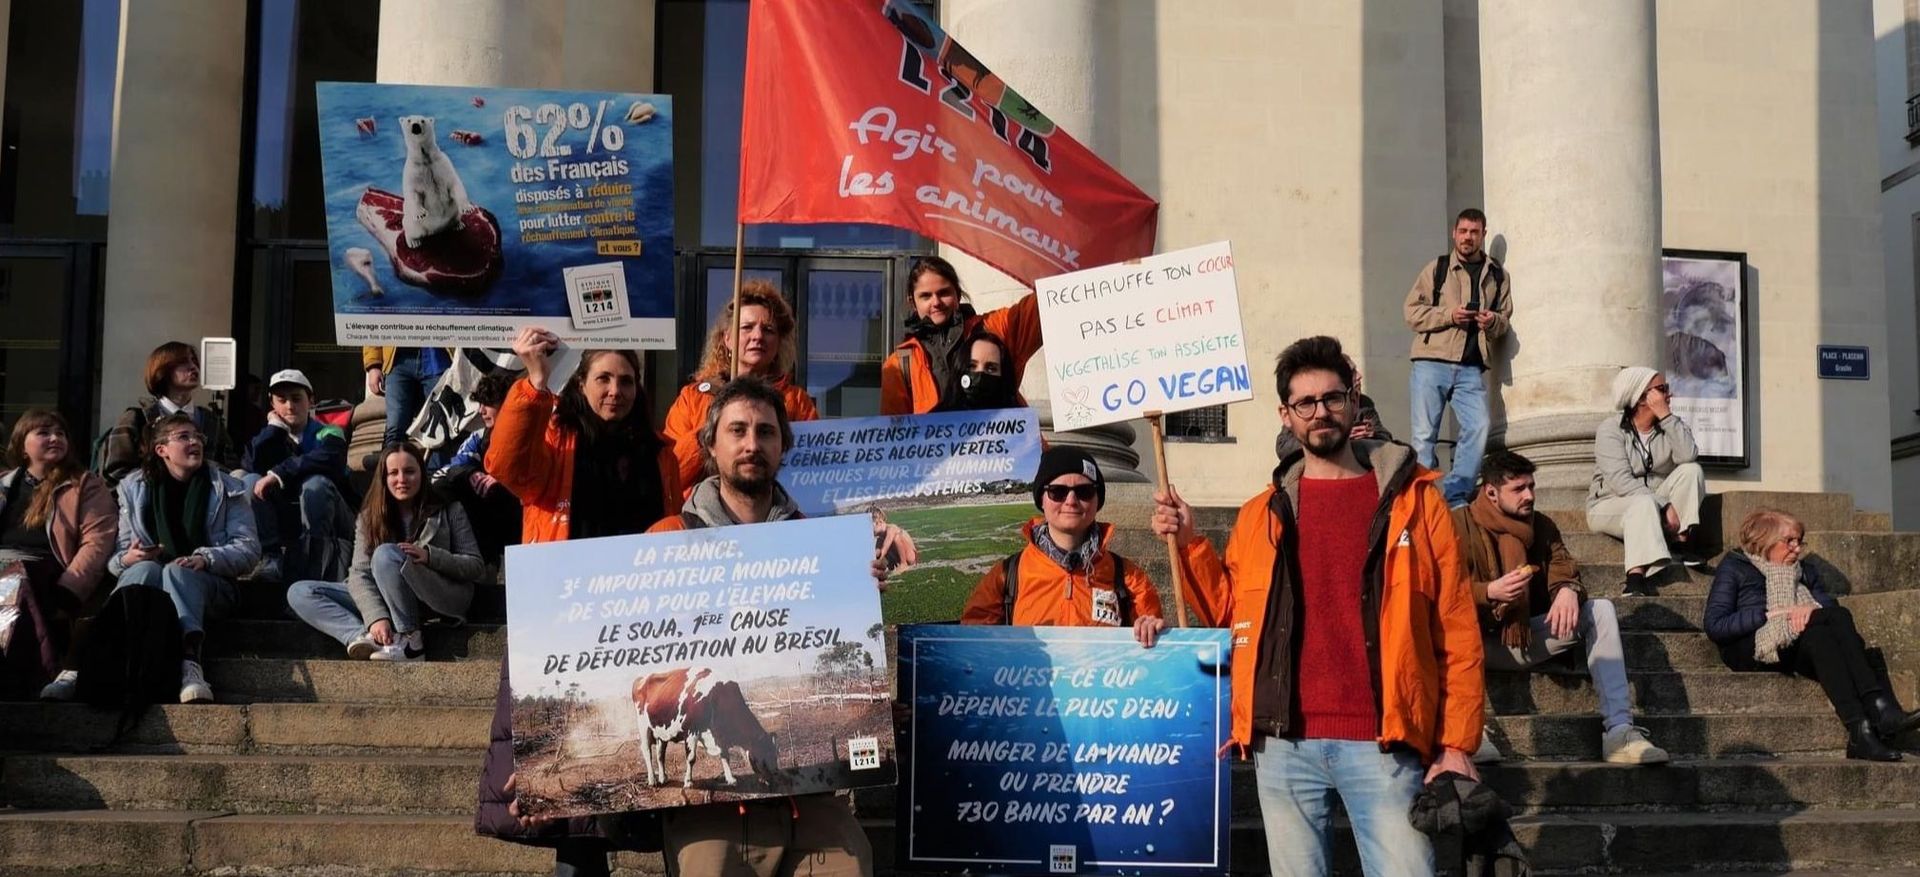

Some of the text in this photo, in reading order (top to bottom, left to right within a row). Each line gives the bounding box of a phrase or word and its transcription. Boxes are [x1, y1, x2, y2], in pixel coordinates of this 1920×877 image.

[898, 34, 1052, 175] L214
[504, 100, 624, 159] 62%
[510, 155, 629, 183] des Français
[849, 107, 1064, 217] Agir pour
[515, 182, 632, 204] disposés à réduire
[520, 209, 636, 232] pour lutter contre le
[839, 155, 1081, 269] les animaux
[600, 243, 610, 252] et
[613, 244, 632, 252] vous
[1046, 270, 1154, 308] RECHAUFFE
[1163, 264, 1192, 281] TON
[346, 323, 379, 331] L'élevage
[380, 323, 413, 331] contribue
[478, 324, 515, 332] climatique.
[1080, 317, 1117, 340] PAS
[1125, 312, 1145, 330] LE
[1175, 334, 1239, 358] ASSIETTE
[1102, 364, 1250, 411] GO VEGAN
[795, 420, 1026, 448] EVAGE INTENSIF DES COCHONS
[854, 447, 885, 463] DES
[888, 443, 944, 460] ALGUES
[791, 456, 1015, 488] TOXIQUES POUR LES HUMAINS
[821, 487, 844, 504] ET
[845, 485, 874, 502] LES
[633, 547, 657, 567] LA
[587, 565, 726, 594] IMPORTATEUR
[732, 555, 820, 581] MONDIAL
[567, 602, 595, 624] DE
[600, 596, 650, 619] SOJA
[656, 591, 710, 613] POUR
[598, 624, 622, 644] LE
[730, 608, 790, 632] CAUSE
[543, 654, 571, 675] DE
[575, 636, 737, 672] DÉFORESTATION
[742, 634, 768, 655] AU
[993, 665, 1139, 688] QU'EST-CE QUI
[938, 691, 1031, 717] DÉPENSE
[1034, 697, 1060, 717] LE
[1065, 697, 1119, 719] PLUS
[1121, 696, 1180, 719] D'EAU
[947, 739, 1183, 764] MANGER DE LA VIANDE
[1000, 771, 1131, 795] OU PRENDRE
[957, 801, 999, 823] 730
[1004, 800, 1071, 824] BAINS
[1074, 801, 1116, 824] PAR
[1121, 802, 1154, 825] AN
